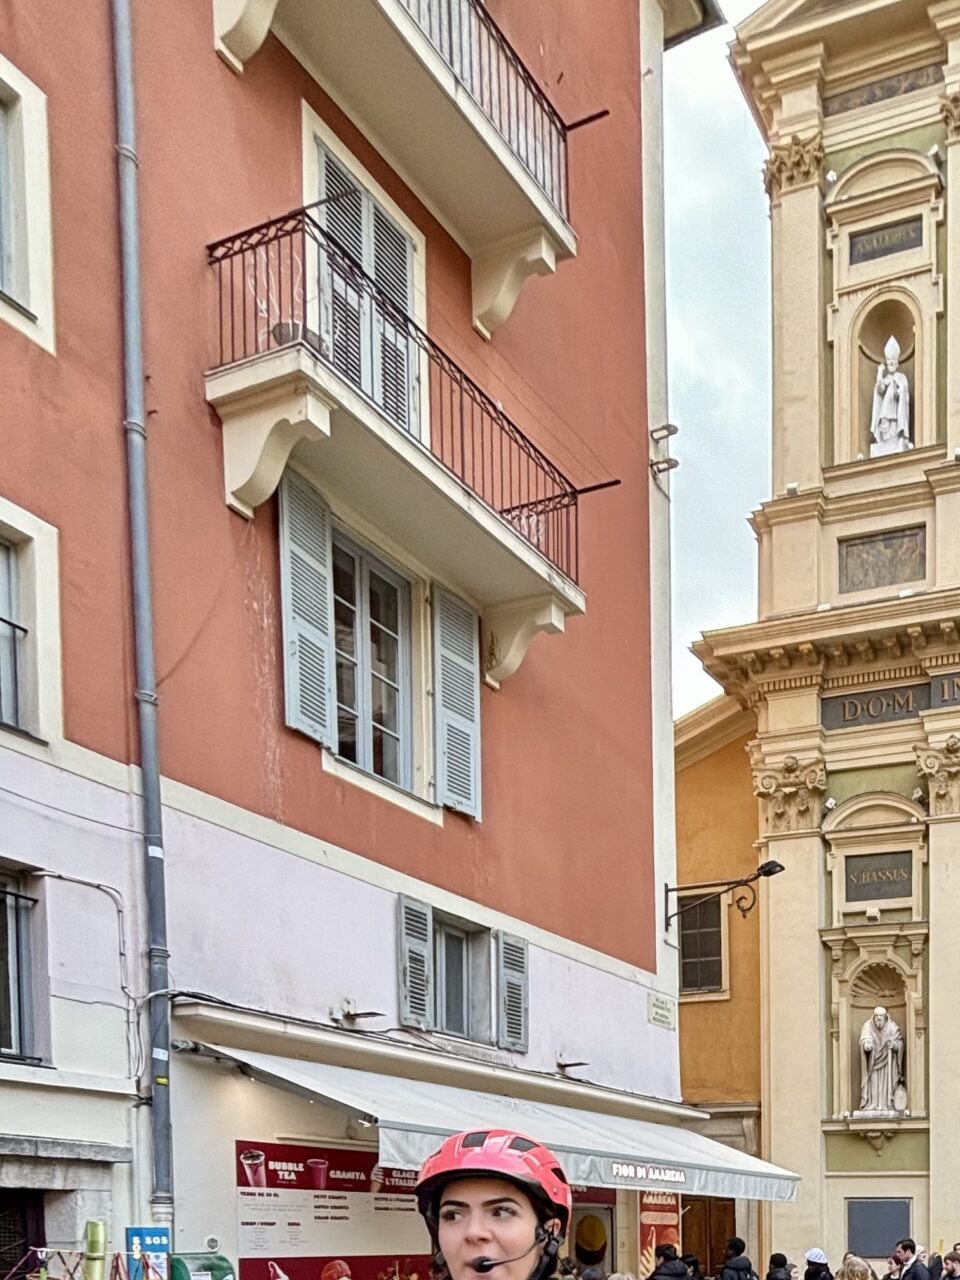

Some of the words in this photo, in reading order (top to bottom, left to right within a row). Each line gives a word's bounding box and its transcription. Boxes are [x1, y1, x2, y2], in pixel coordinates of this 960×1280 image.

[862, 868, 909, 884] BASSUS
[268, 1160, 304, 1172] BUBBLE
[277, 1171, 296, 1180] TEA
[329, 1169, 366, 1181] GRANITA
[612, 1162, 635, 1178] FIOR
[636, 1165, 647, 1179] DI
[648, 1167, 686, 1183] AMARENA
[145, 1236, 168, 1245] SOS
